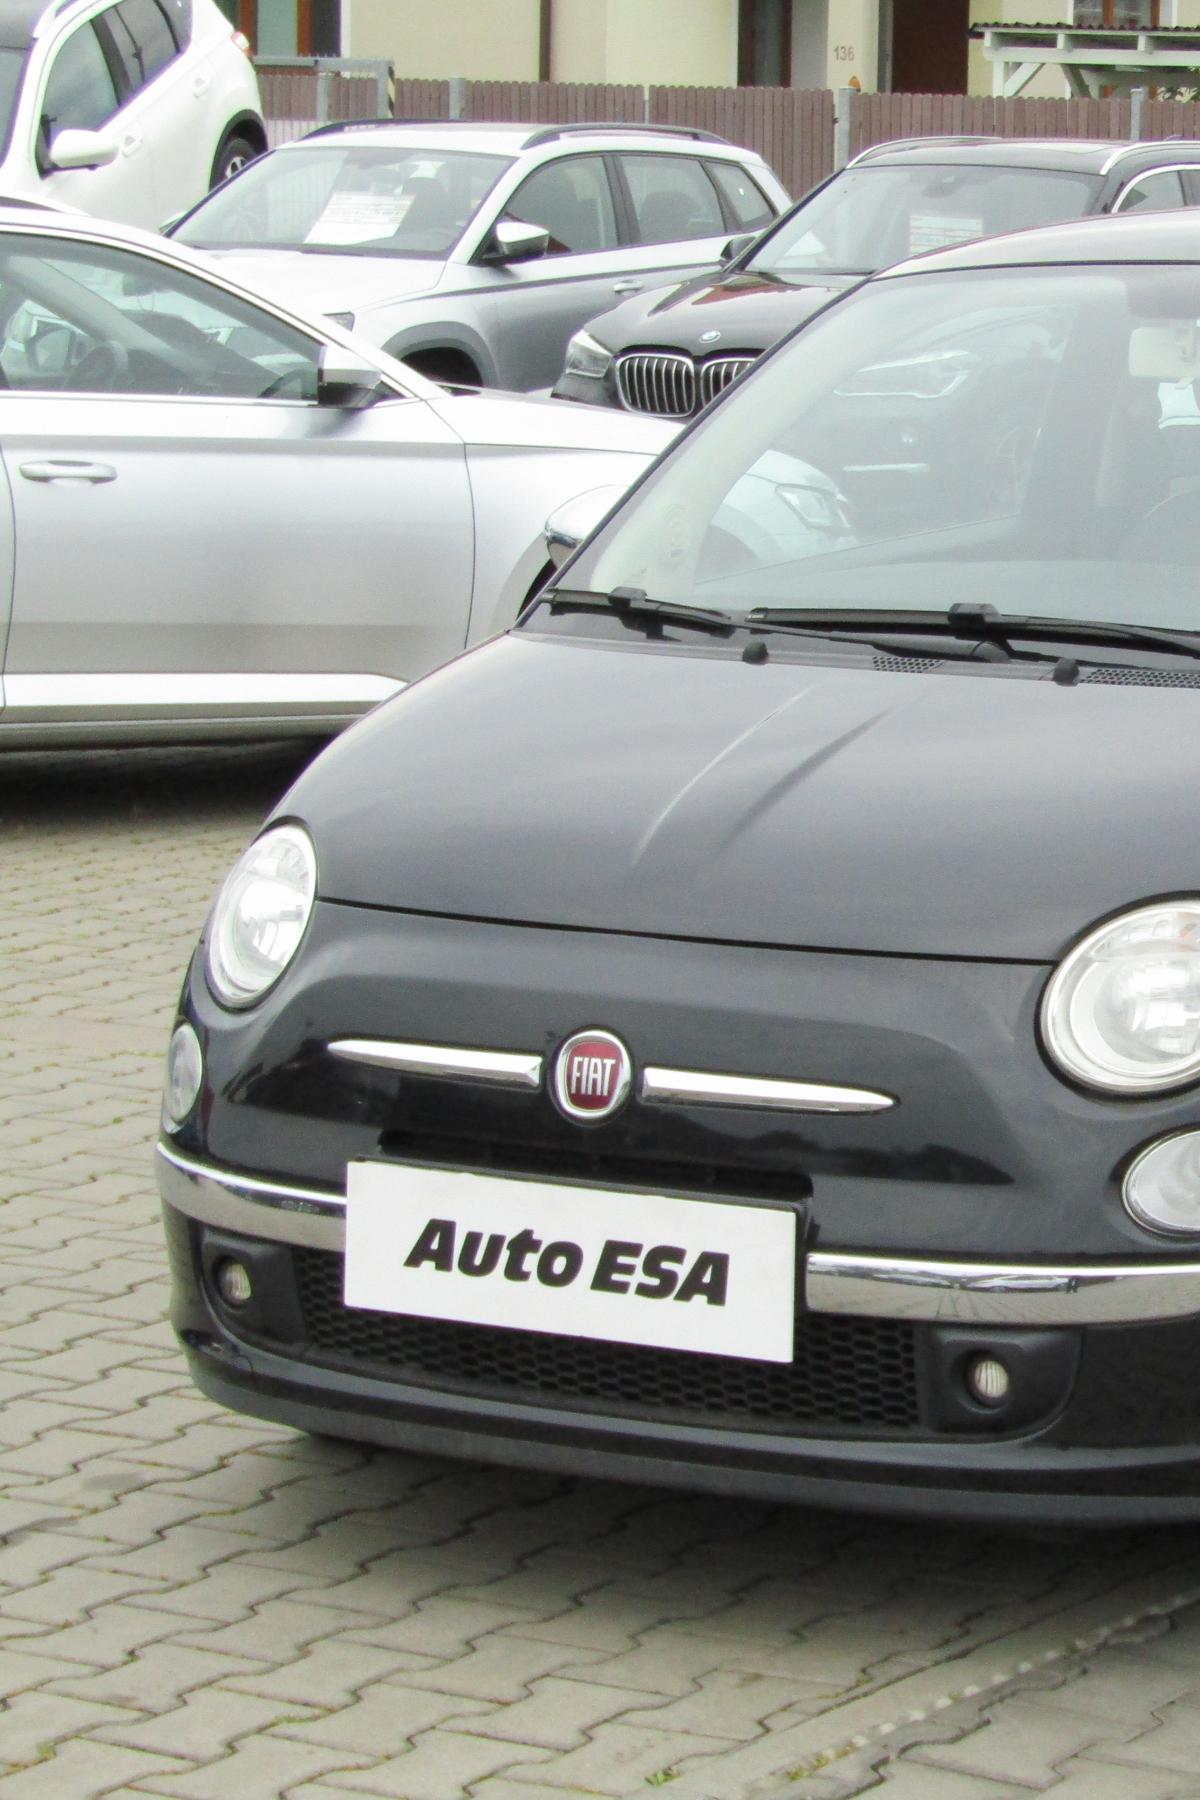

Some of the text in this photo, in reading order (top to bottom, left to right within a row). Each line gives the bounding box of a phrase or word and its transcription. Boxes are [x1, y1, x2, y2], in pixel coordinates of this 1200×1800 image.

[833, 45, 855, 61] 136
[570, 1056, 616, 1096] FIAT
[403, 1218, 730, 1307] Auto ESA
